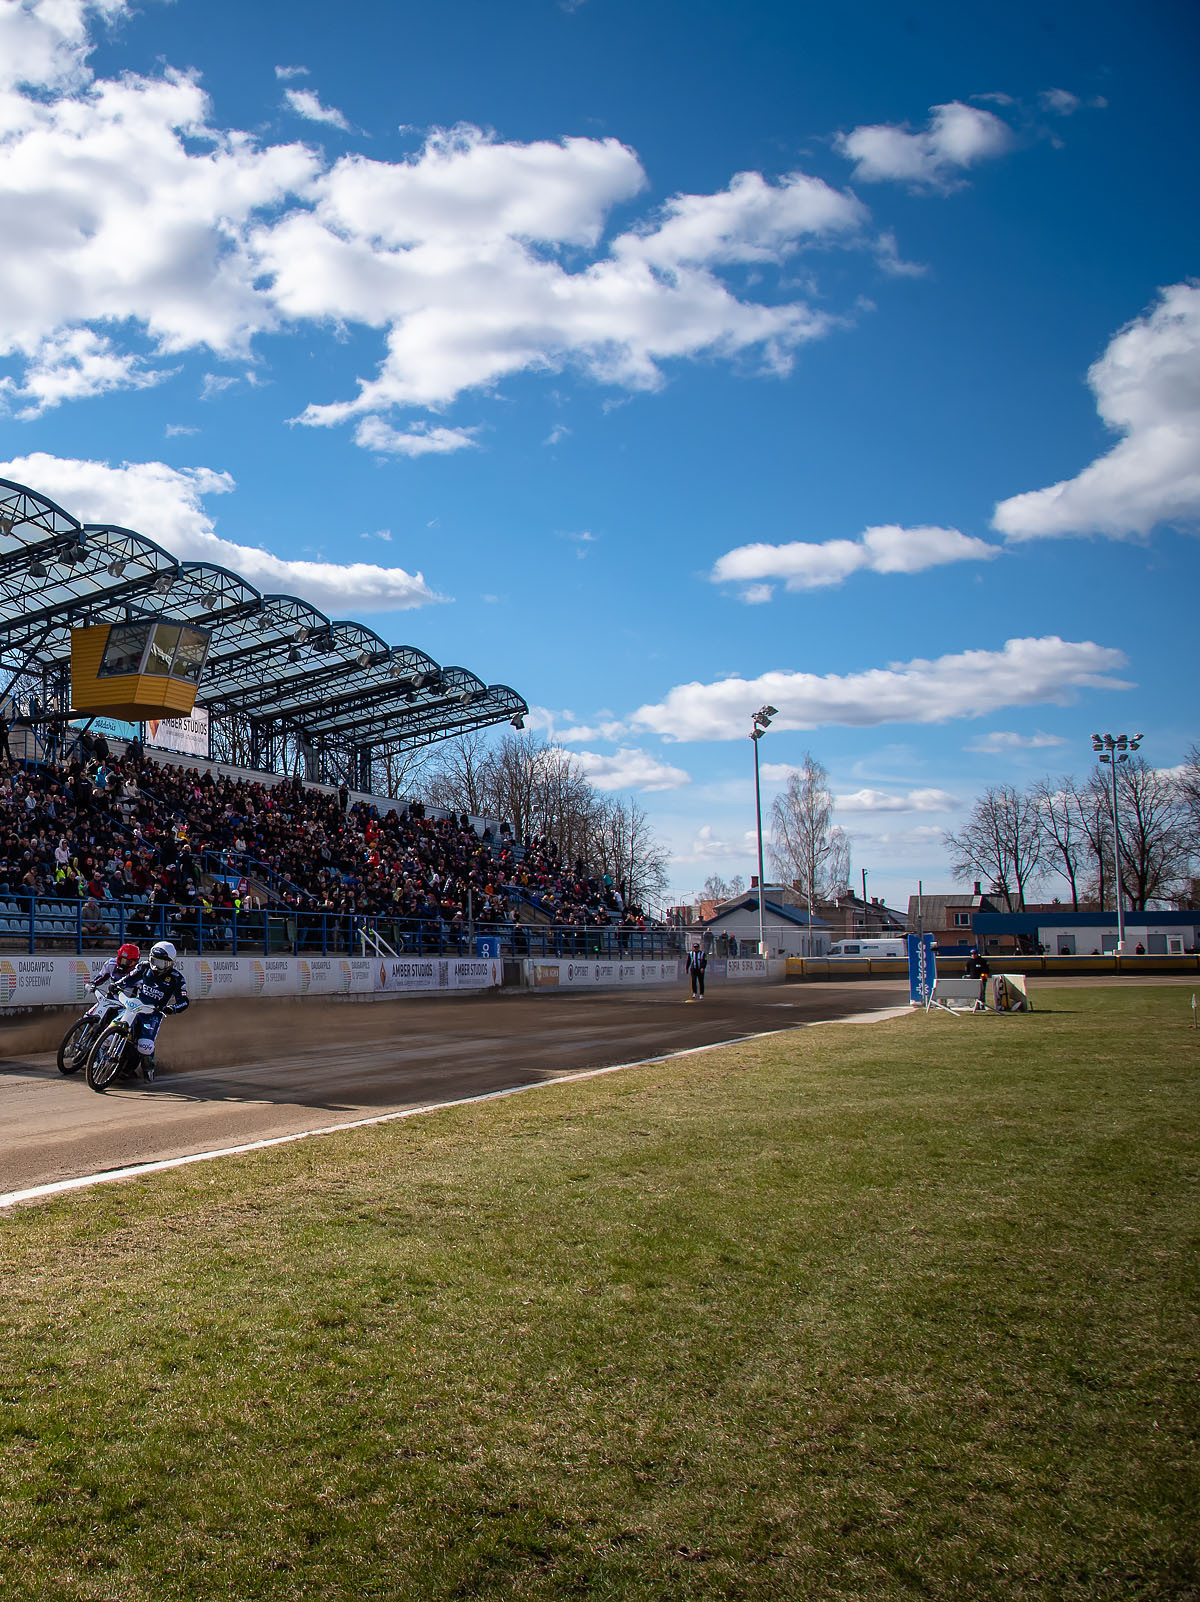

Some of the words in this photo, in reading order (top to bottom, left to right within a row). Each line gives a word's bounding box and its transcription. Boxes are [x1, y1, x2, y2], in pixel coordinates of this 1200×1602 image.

[162, 718, 182, 730] AMBER
[184, 721, 207, 735] STUDIOS
[18, 961, 54, 973] DAUGAVPILS
[213, 961, 238, 971] DAUGAVPILS
[265, 961, 288, 971] DAUGAVPILS
[392, 963, 410, 977] AMBER
[411, 963, 433, 977] STUDIOS
[455, 963, 470, 976] AMBER
[470, 963, 488, 976] STUDIOS
[19, 976, 25, 987] IS
[25, 976, 52, 987] SPEEDWAY
